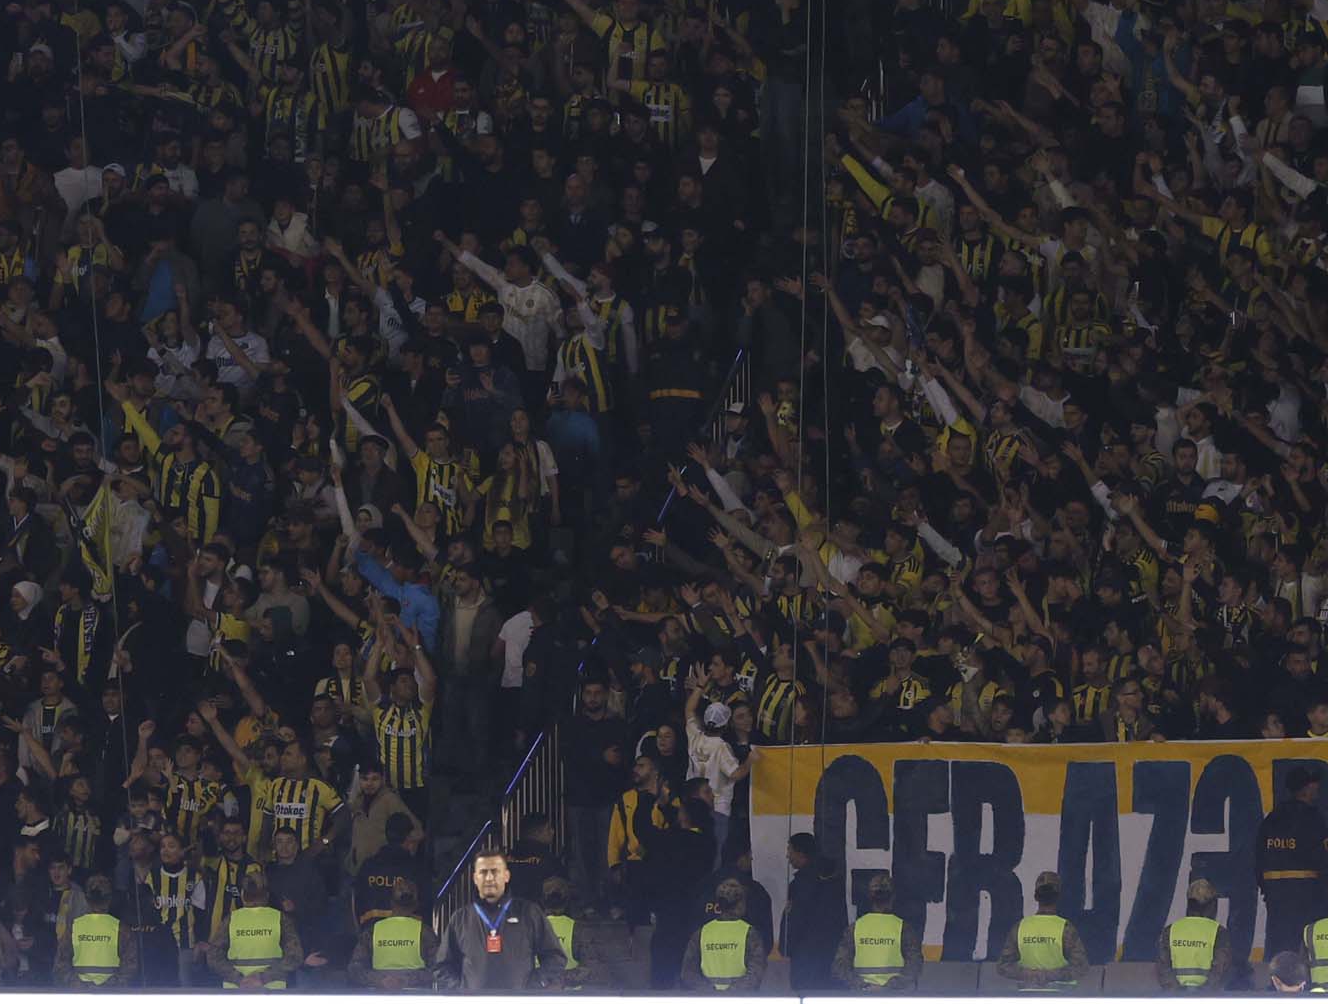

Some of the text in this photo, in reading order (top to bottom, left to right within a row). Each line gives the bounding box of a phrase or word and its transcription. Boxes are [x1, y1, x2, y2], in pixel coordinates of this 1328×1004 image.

[236, 928, 273, 937] SECURITY
[78, 934, 112, 942] SECURITY
[859, 937, 895, 946] SECURITY
[1023, 935, 1056, 944] SECURITY
[378, 939, 414, 947] SECURITY
[706, 943, 738, 951] SECURITY
[1172, 939, 1207, 948] SECURITY
